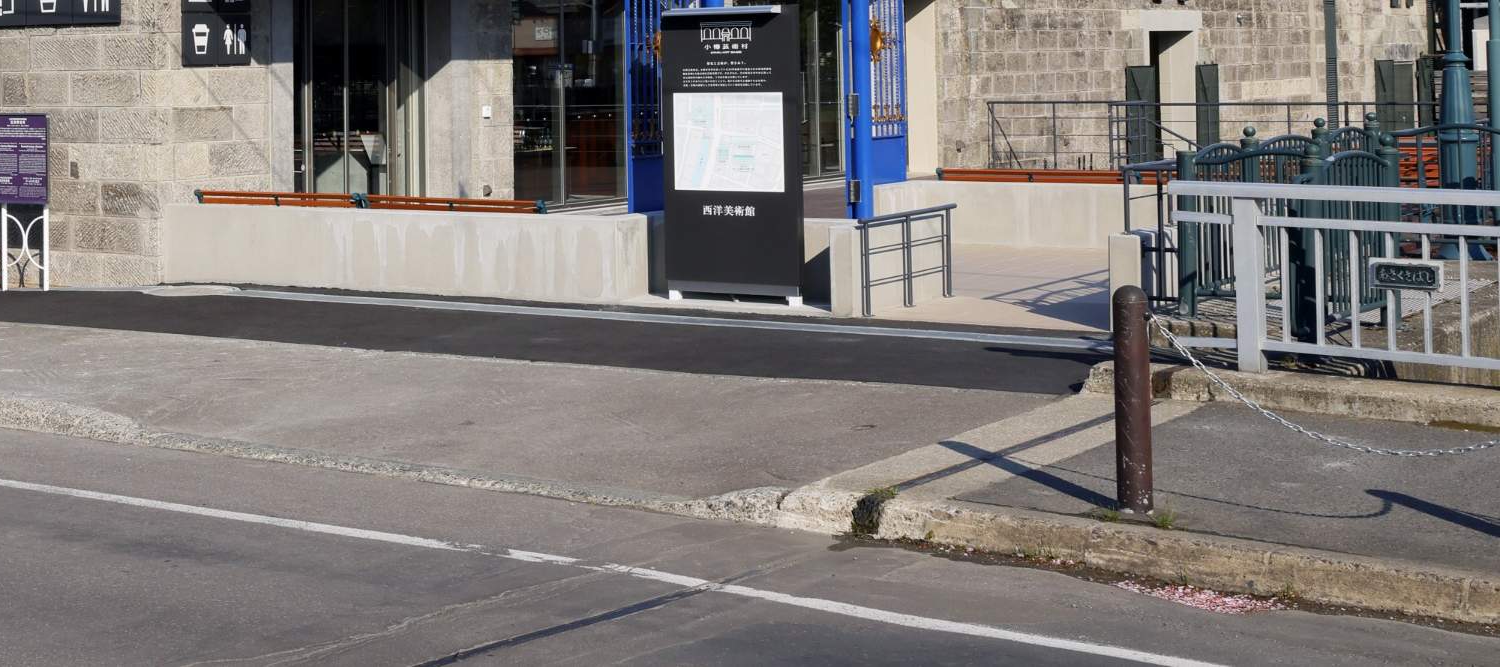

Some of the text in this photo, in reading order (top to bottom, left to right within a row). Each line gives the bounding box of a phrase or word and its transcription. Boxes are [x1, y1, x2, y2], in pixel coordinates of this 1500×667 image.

[703, 204, 756, 217] 西洋美術館
